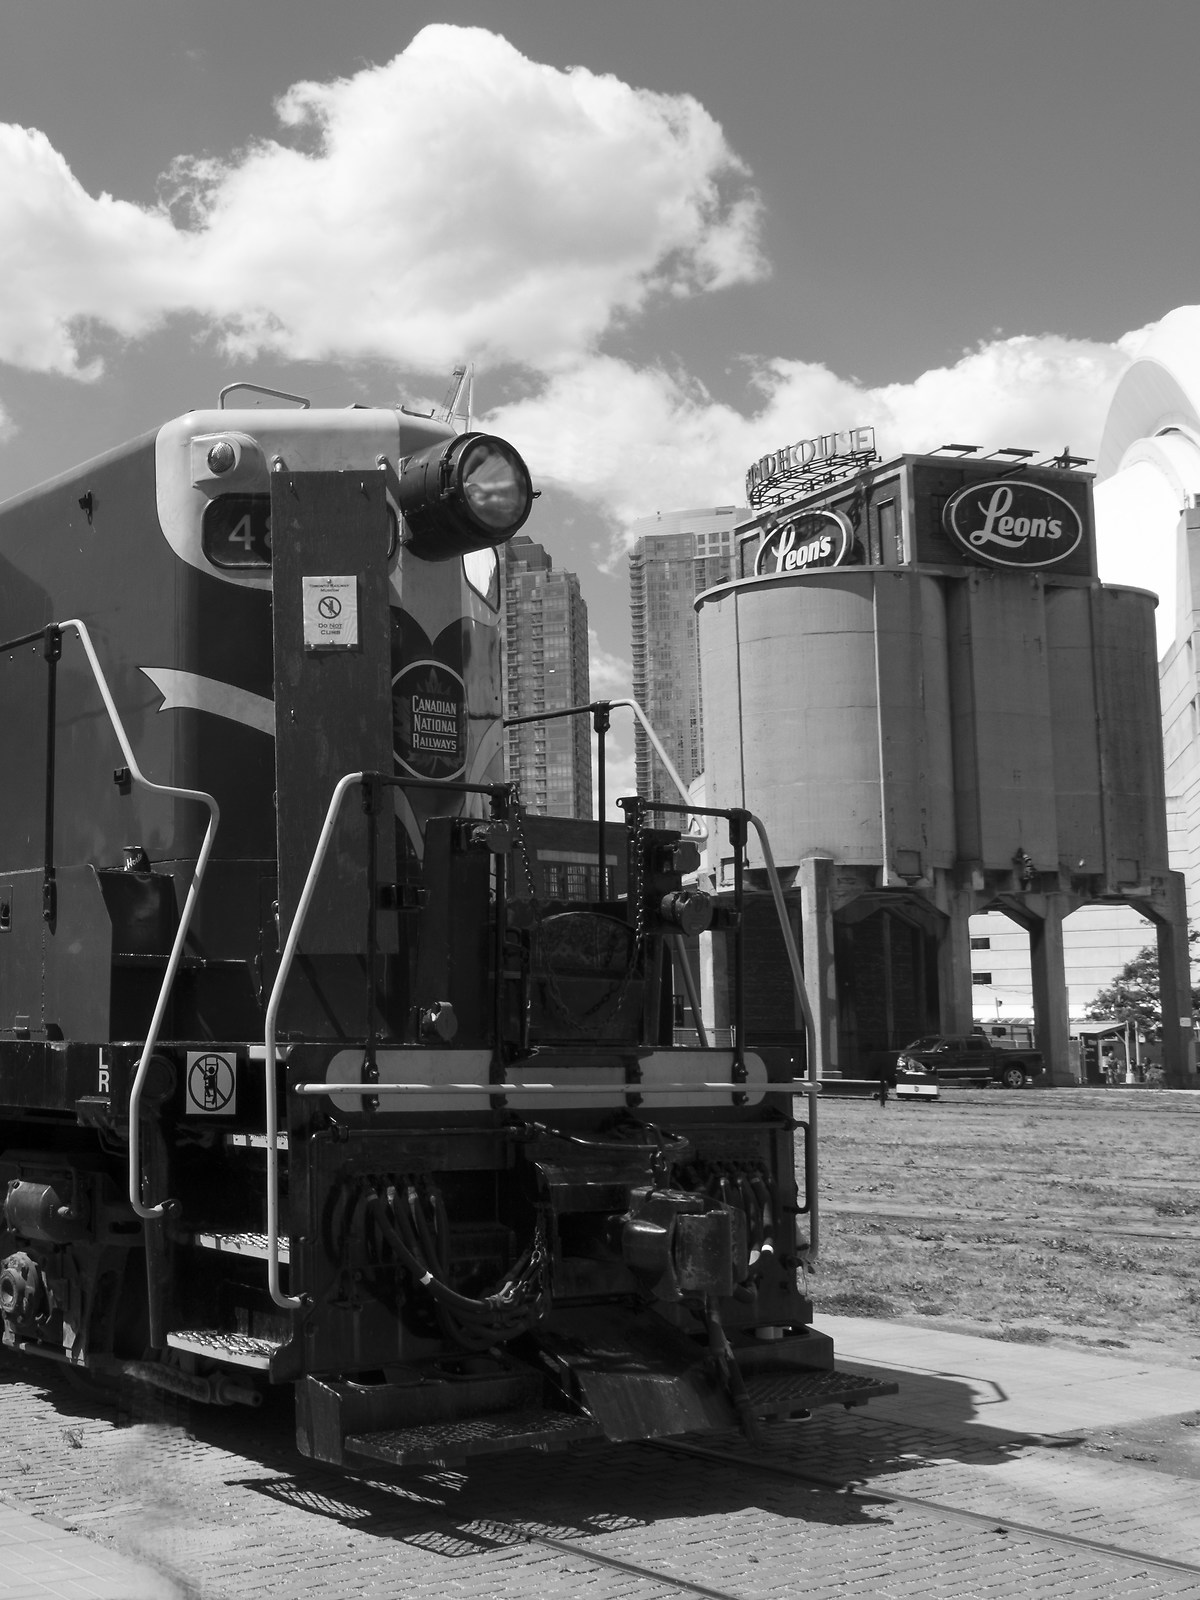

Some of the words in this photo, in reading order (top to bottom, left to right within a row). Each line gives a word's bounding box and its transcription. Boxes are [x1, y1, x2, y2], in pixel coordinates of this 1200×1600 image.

[228, 513, 271, 551] 4
[969, 487, 1062, 548] Leon's
[771, 523, 832, 573] Leon's
[412, 695, 457, 715] CANADIAN
[414, 714, 457, 734] NATIONAL
[412, 733, 457, 750] RAILWAYS
